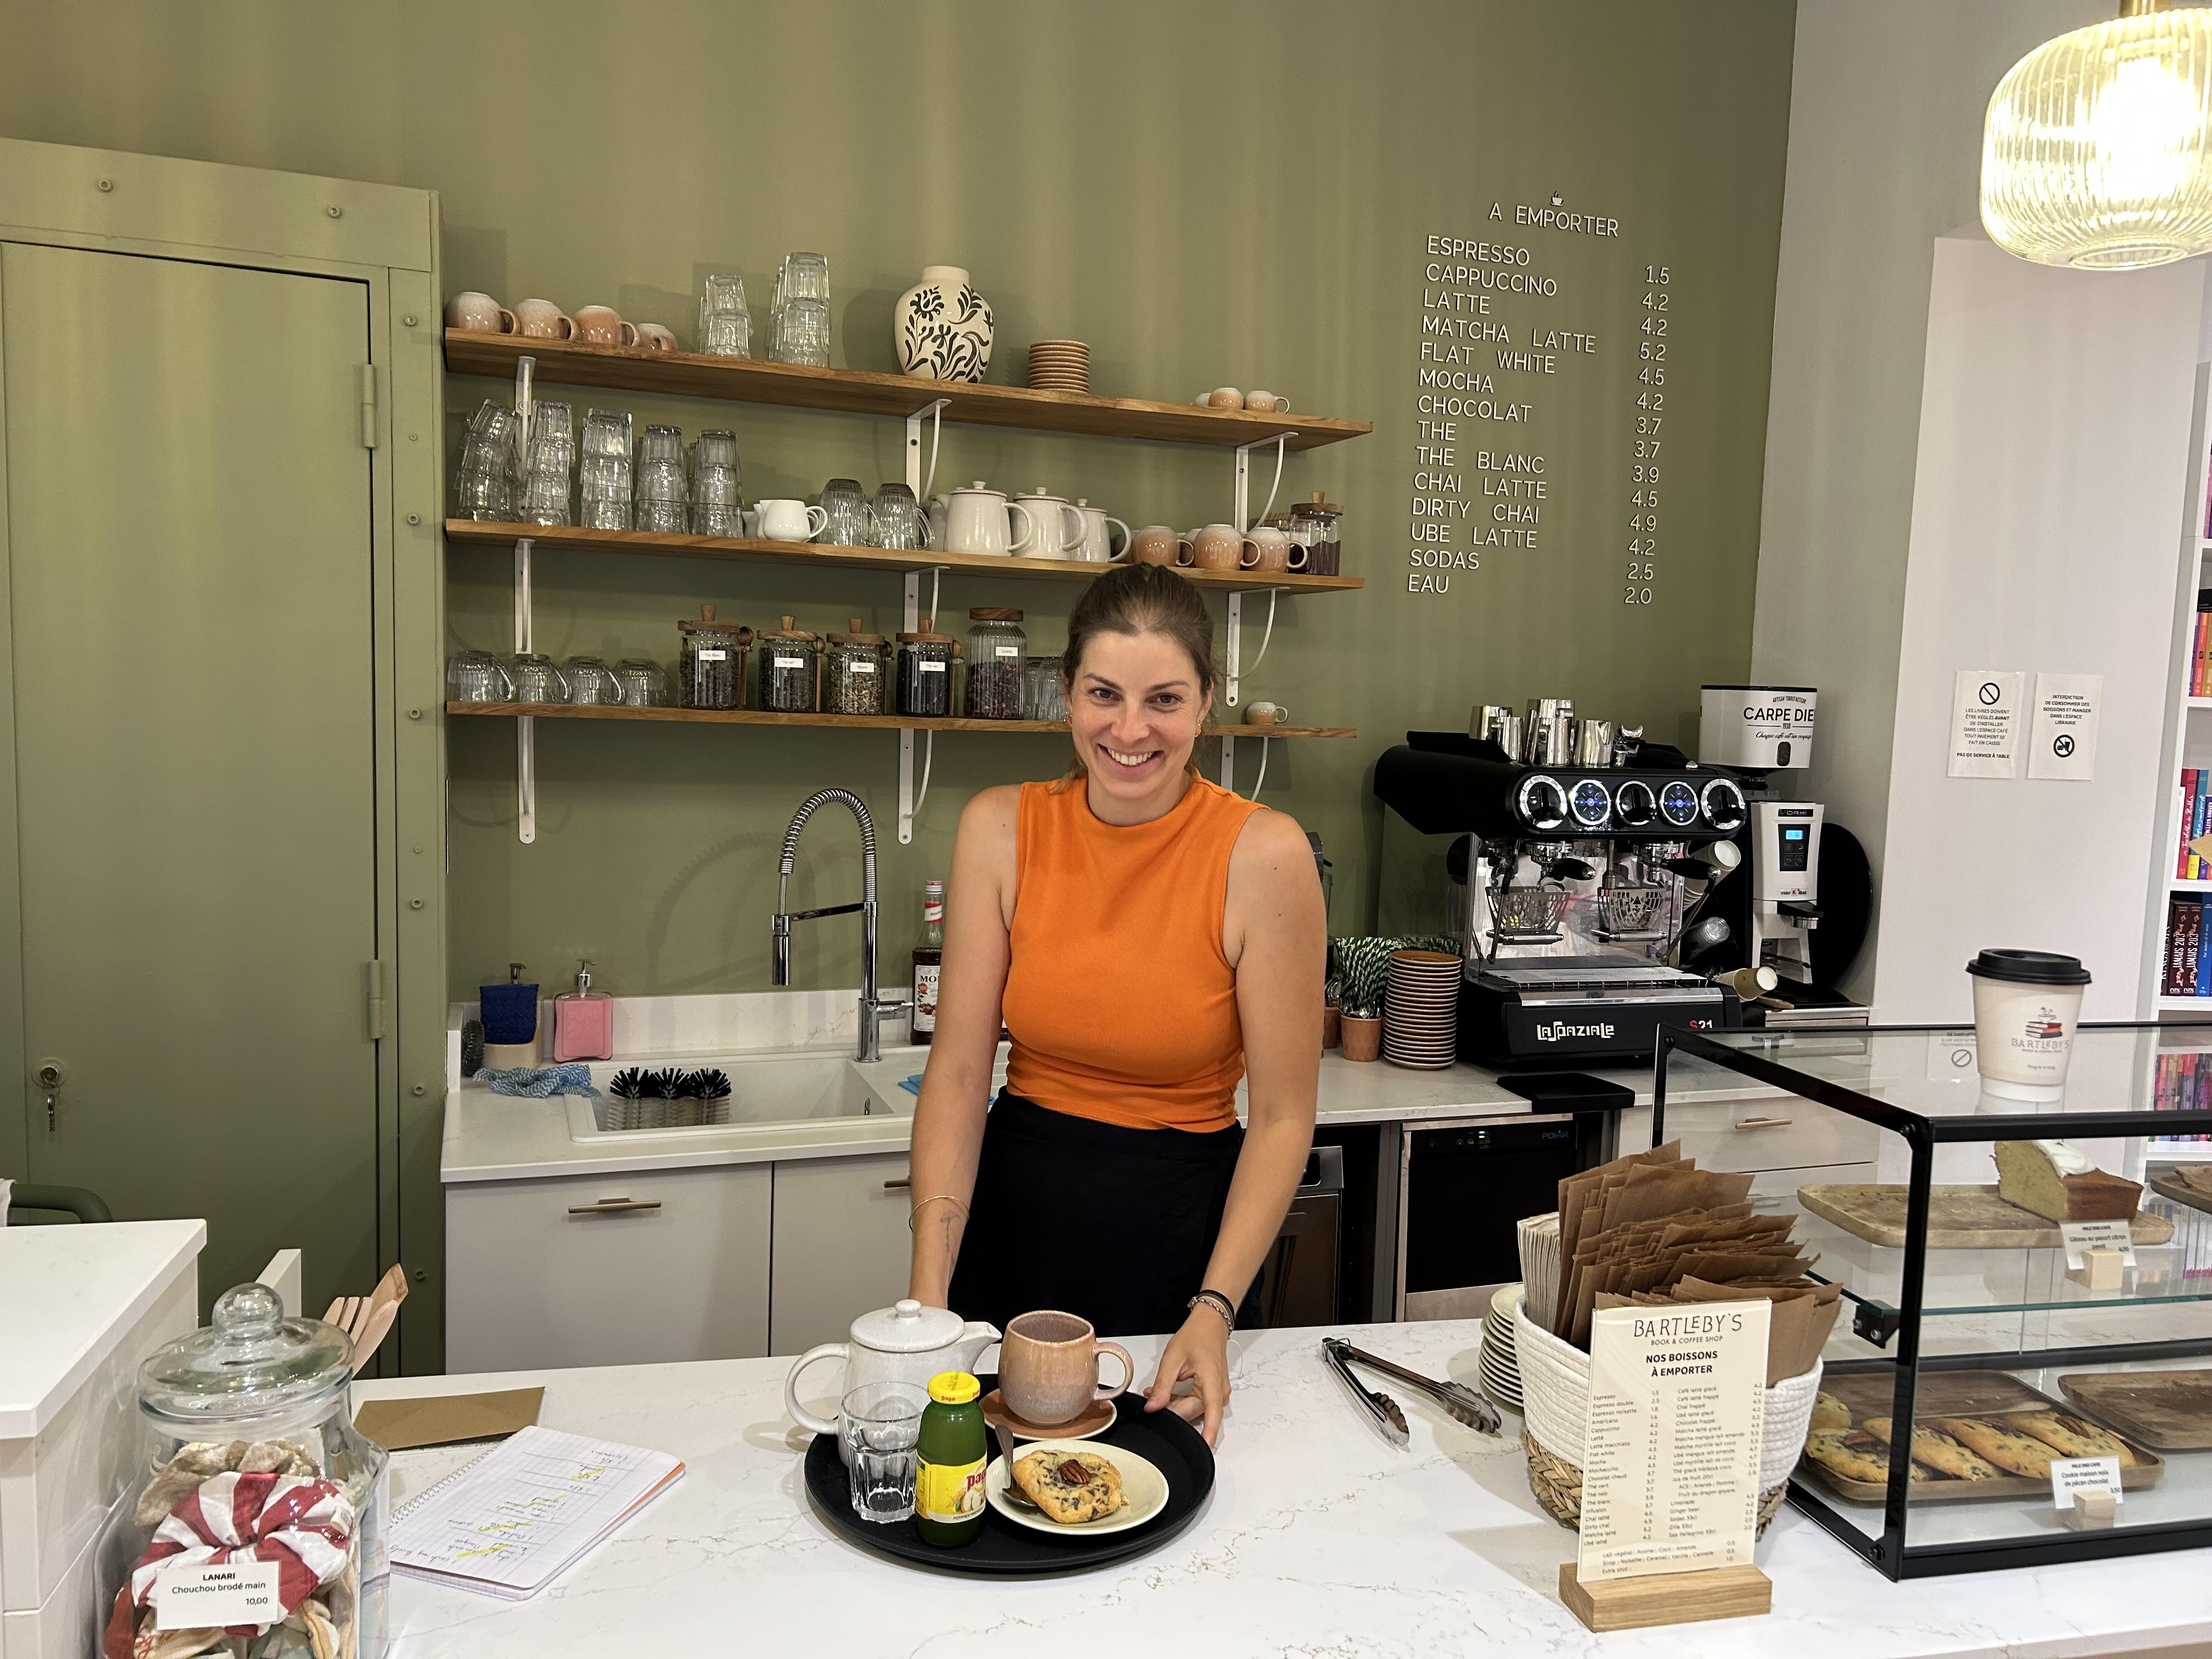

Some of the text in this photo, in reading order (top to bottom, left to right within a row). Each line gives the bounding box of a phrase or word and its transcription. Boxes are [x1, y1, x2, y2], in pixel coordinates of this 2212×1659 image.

[1489, 203, 1618, 236] A EMPORTER
[1427, 235, 1530, 268] ESPRESSO
[1425, 261, 1556, 298] CAPPUCCINO
[1646, 266, 1669, 284] 1.5
[1425, 289, 1490, 314] LATTE
[1643, 292, 1668, 311] 4.2
[1422, 315, 1595, 353] MATCHA LATTE
[1641, 318, 1667, 336] 4.2
[1421, 342, 1555, 373] FLAT WHITE
[1640, 342, 1666, 361] 5.2
[1420, 369, 1493, 393] MOCHA
[1639, 368, 1664, 385] 4.5
[1418, 396, 1532, 425] CHOCOLAT
[1638, 392, 1663, 410] 4.2
[1418, 421, 1456, 441] THE
[1637, 417, 1661, 435] 3.7
[1635, 441, 1660, 458] 3.7
[1417, 447, 1544, 473] THE BLANC
[1633, 466, 1658, 483] 3.9
[1415, 472, 1547, 499] CHAI LATTE
[1632, 490, 1657, 507] 4.5
[1413, 498, 1538, 523] DIRTY CHAI
[1630, 514, 1656, 531] 4.9
[1412, 523, 1537, 548] UBE LATTE
[1629, 539, 1655, 555] 4.2
[1410, 549, 1479, 569] SODAS
[1628, 563, 1653, 580] 2.5
[1409, 574, 1448, 593] EAU
[1626, 588, 1651, 603] 2.0
[1743, 707, 1791, 721] CARPE
[2172, 947, 2184, 970] JAMAIS
[2186, 947, 2197, 970] JAMAIS
[1689, 1020, 1712, 1029] S21
[1542, 1130, 1569, 1139] POLAR
[1634, 1313, 1742, 1338] BARTLEBY'S
[1646, 1351, 1718, 1363] NOS BOISSONS
[1651, 1365, 1712, 1376] À EMPORTER
[967, 1468, 987, 1492] pag
[203, 1572, 235, 1582] LANARI
[172, 1582, 266, 1594] Chouchou brodé main
[246, 1597, 268, 1606] 10,00
